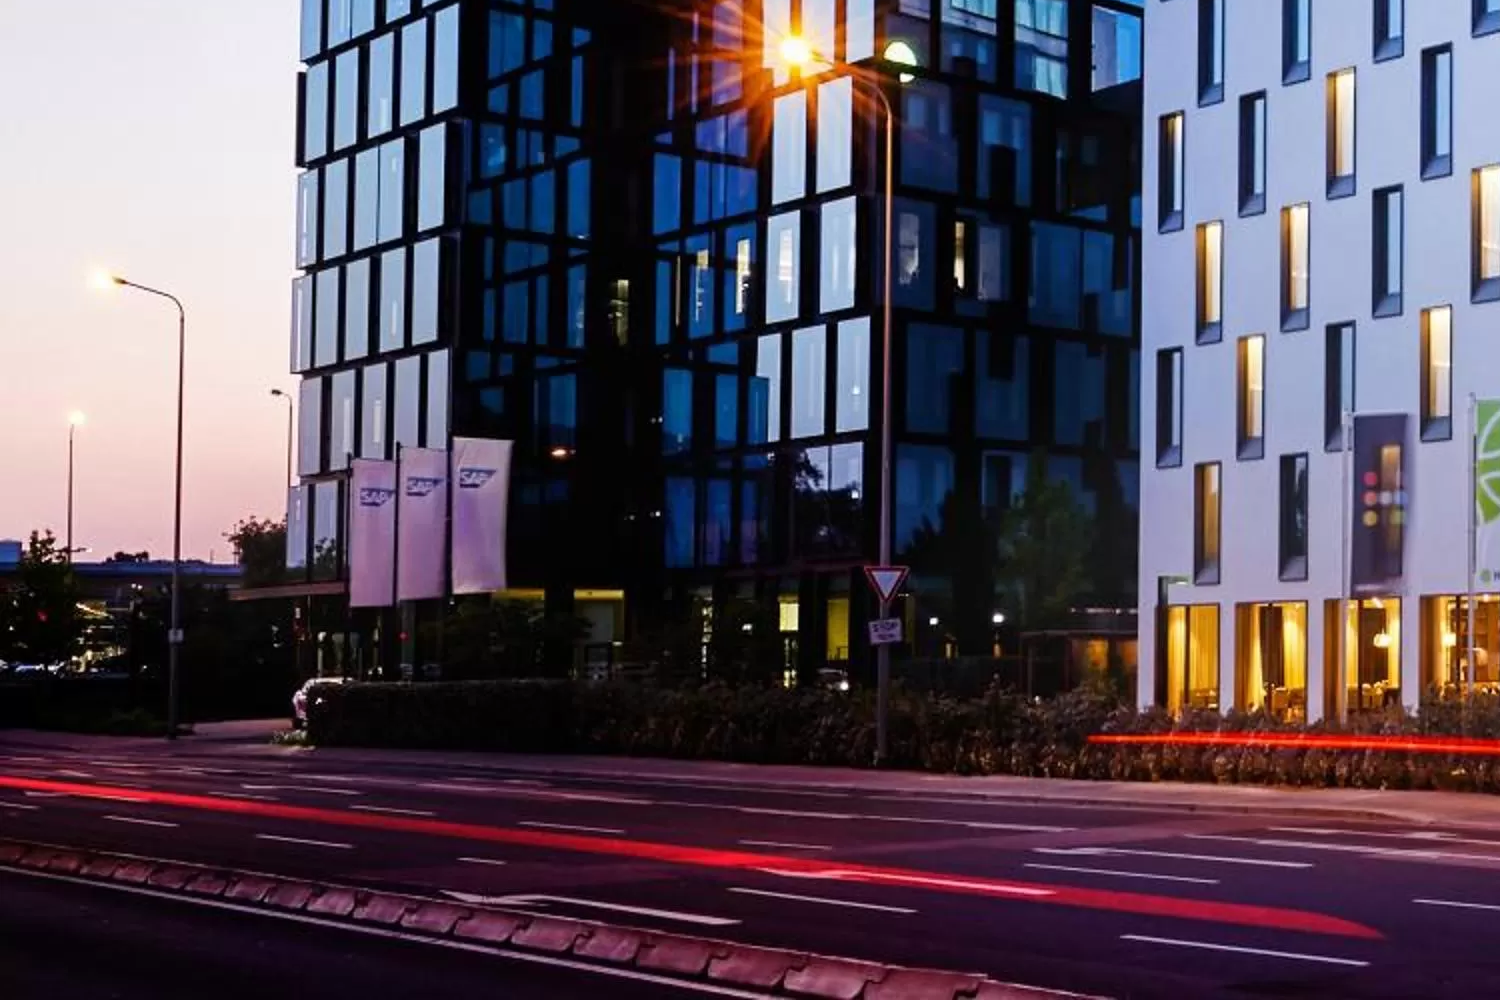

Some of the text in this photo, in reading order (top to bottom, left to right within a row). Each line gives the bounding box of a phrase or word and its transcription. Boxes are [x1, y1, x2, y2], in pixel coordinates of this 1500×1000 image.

[406, 478, 440, 495] SAP
[460, 469, 492, 487] SAP
[360, 489, 392, 506] SAP
